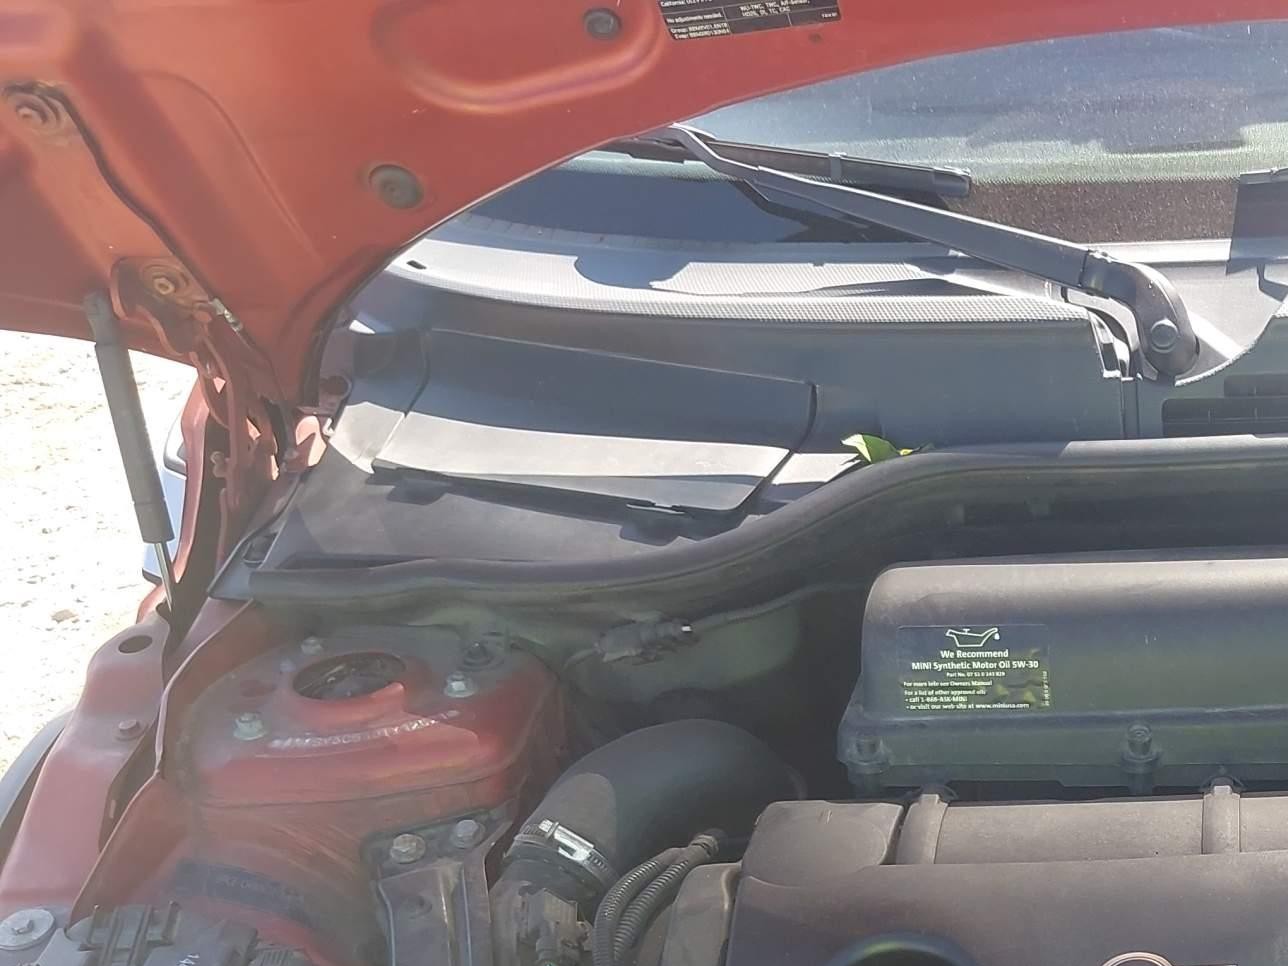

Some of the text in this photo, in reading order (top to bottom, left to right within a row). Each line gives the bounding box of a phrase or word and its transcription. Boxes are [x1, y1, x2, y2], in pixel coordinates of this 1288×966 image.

[940, 649, 1009, 659] We Recommend
[911, 660, 1039, 672] MINI Synthetic Motor Oil 5W-30
